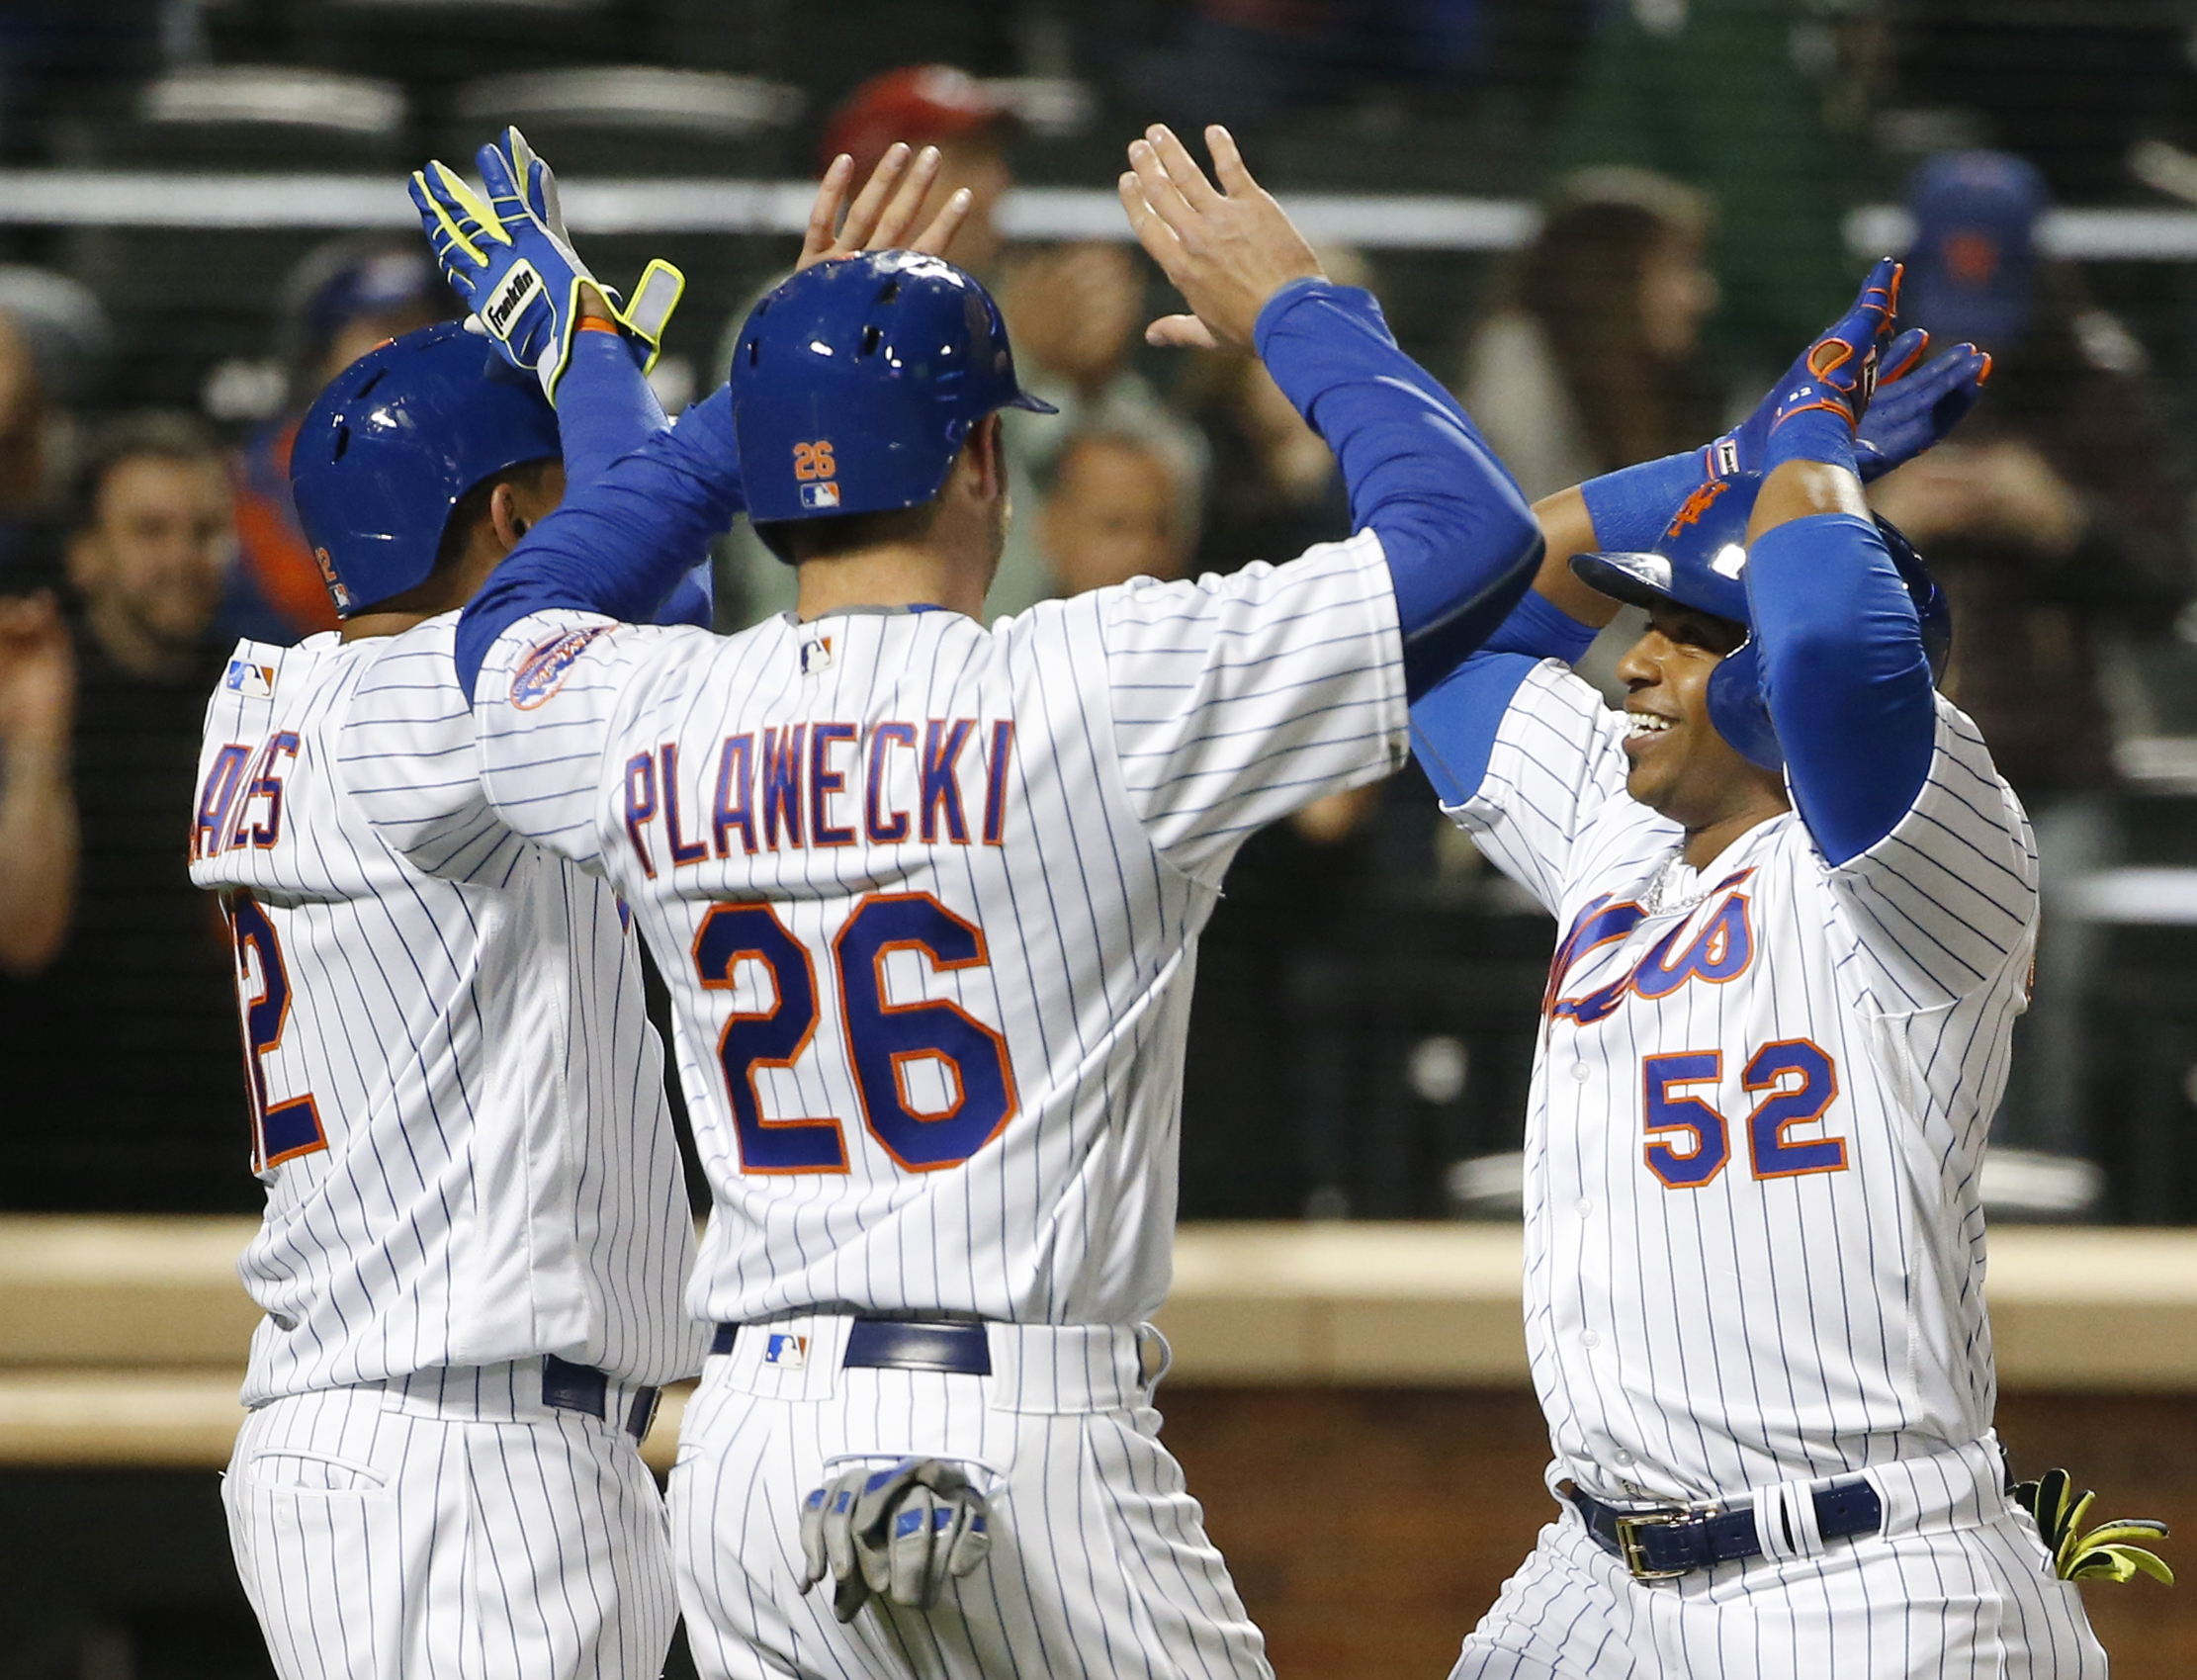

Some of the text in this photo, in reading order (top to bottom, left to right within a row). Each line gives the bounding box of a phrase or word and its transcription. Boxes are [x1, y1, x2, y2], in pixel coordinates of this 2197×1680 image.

[793, 440, 836, 481] 26
[314, 546, 337, 583] 2
[625, 718, 1013, 880] PLAWECKI
[690, 891, 1019, 1176] 26
[1642, 1036, 1850, 1190] 52
